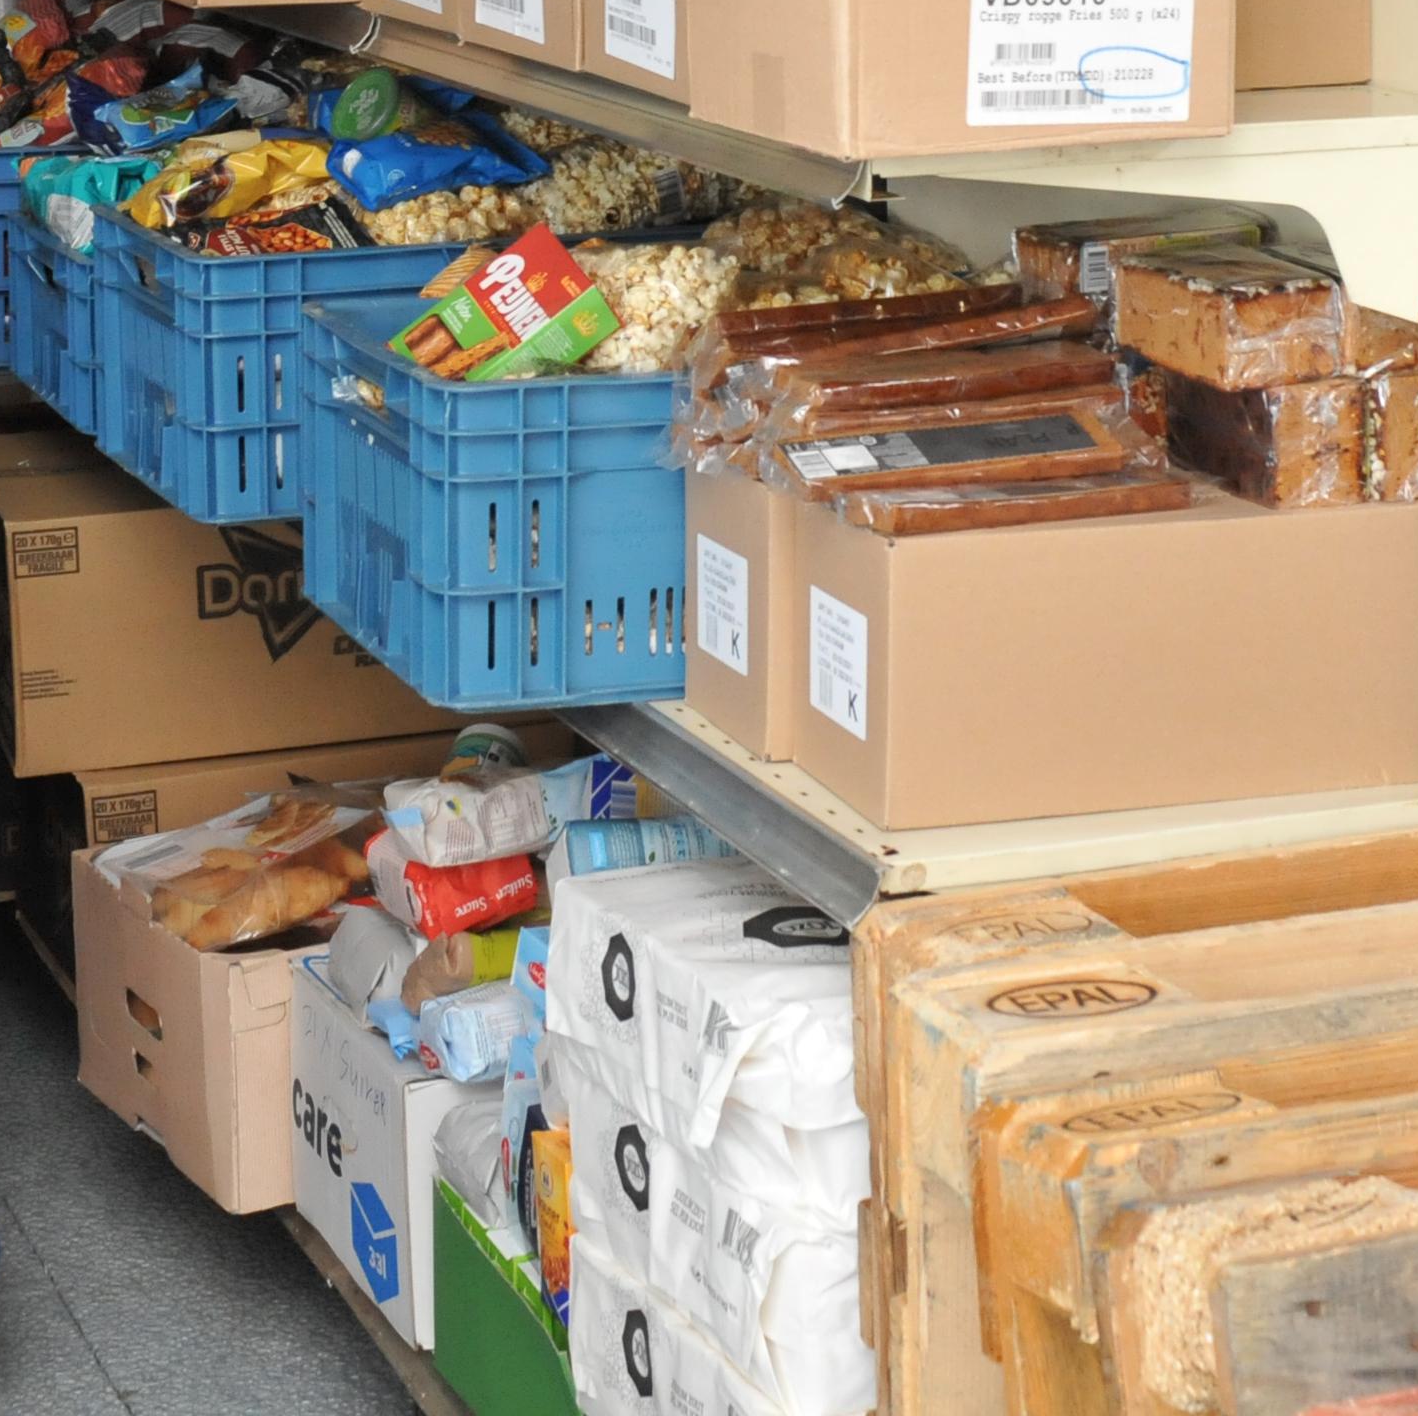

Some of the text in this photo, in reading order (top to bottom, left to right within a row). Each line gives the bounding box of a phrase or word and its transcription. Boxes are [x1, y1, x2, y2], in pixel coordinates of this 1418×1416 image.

[979, 9, 1022, 25] Crispy
[1069, 9, 1102, 21] Fries
[1109, 8, 1129, 20] 500
[977, 72, 1005, 84] Best
[18, 550, 74, 565] BREEKBAAR
[27, 562, 65, 574] FRAGILE
[731, 629, 741, 660] K
[847, 689, 859, 723] K
[454, 895, 489, 918] Sucre
[1017, 984, 1136, 1014] EPAL
[292, 1078, 343, 1178] care
